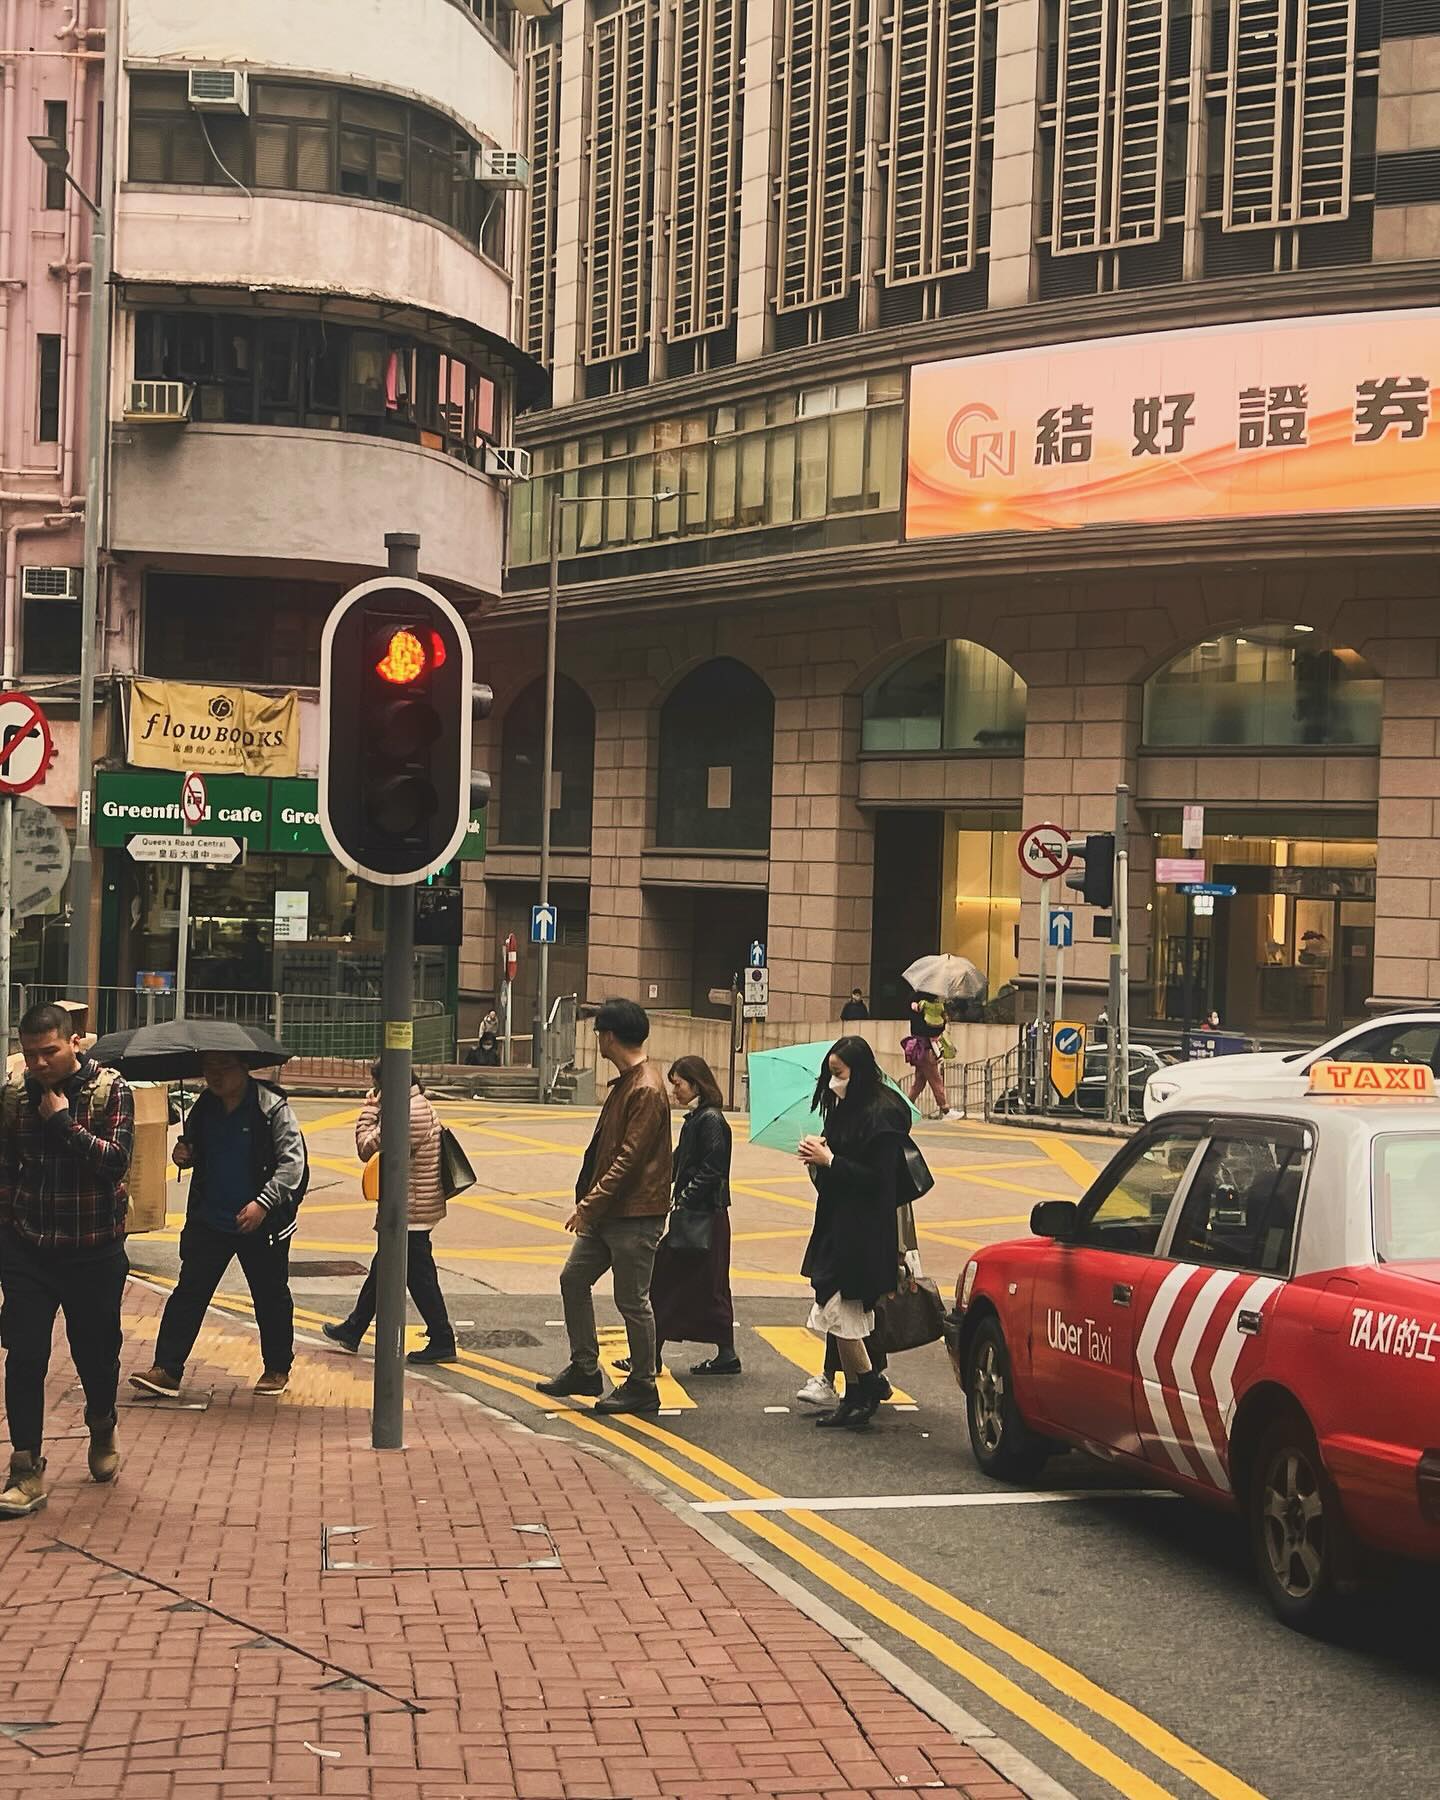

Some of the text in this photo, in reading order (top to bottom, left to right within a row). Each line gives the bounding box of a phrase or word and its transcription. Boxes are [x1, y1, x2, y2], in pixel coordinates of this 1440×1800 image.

[1034, 376, 1430, 466] 結好證券
[218, 807, 263, 822] cafe
[142, 837, 227, 848] Queen's Road Central
[159, 849, 210, 859] 皇后大道中
[1327, 1066, 1426, 1090] TAXI
[1047, 1308, 1112, 1365] Uber Taxi
